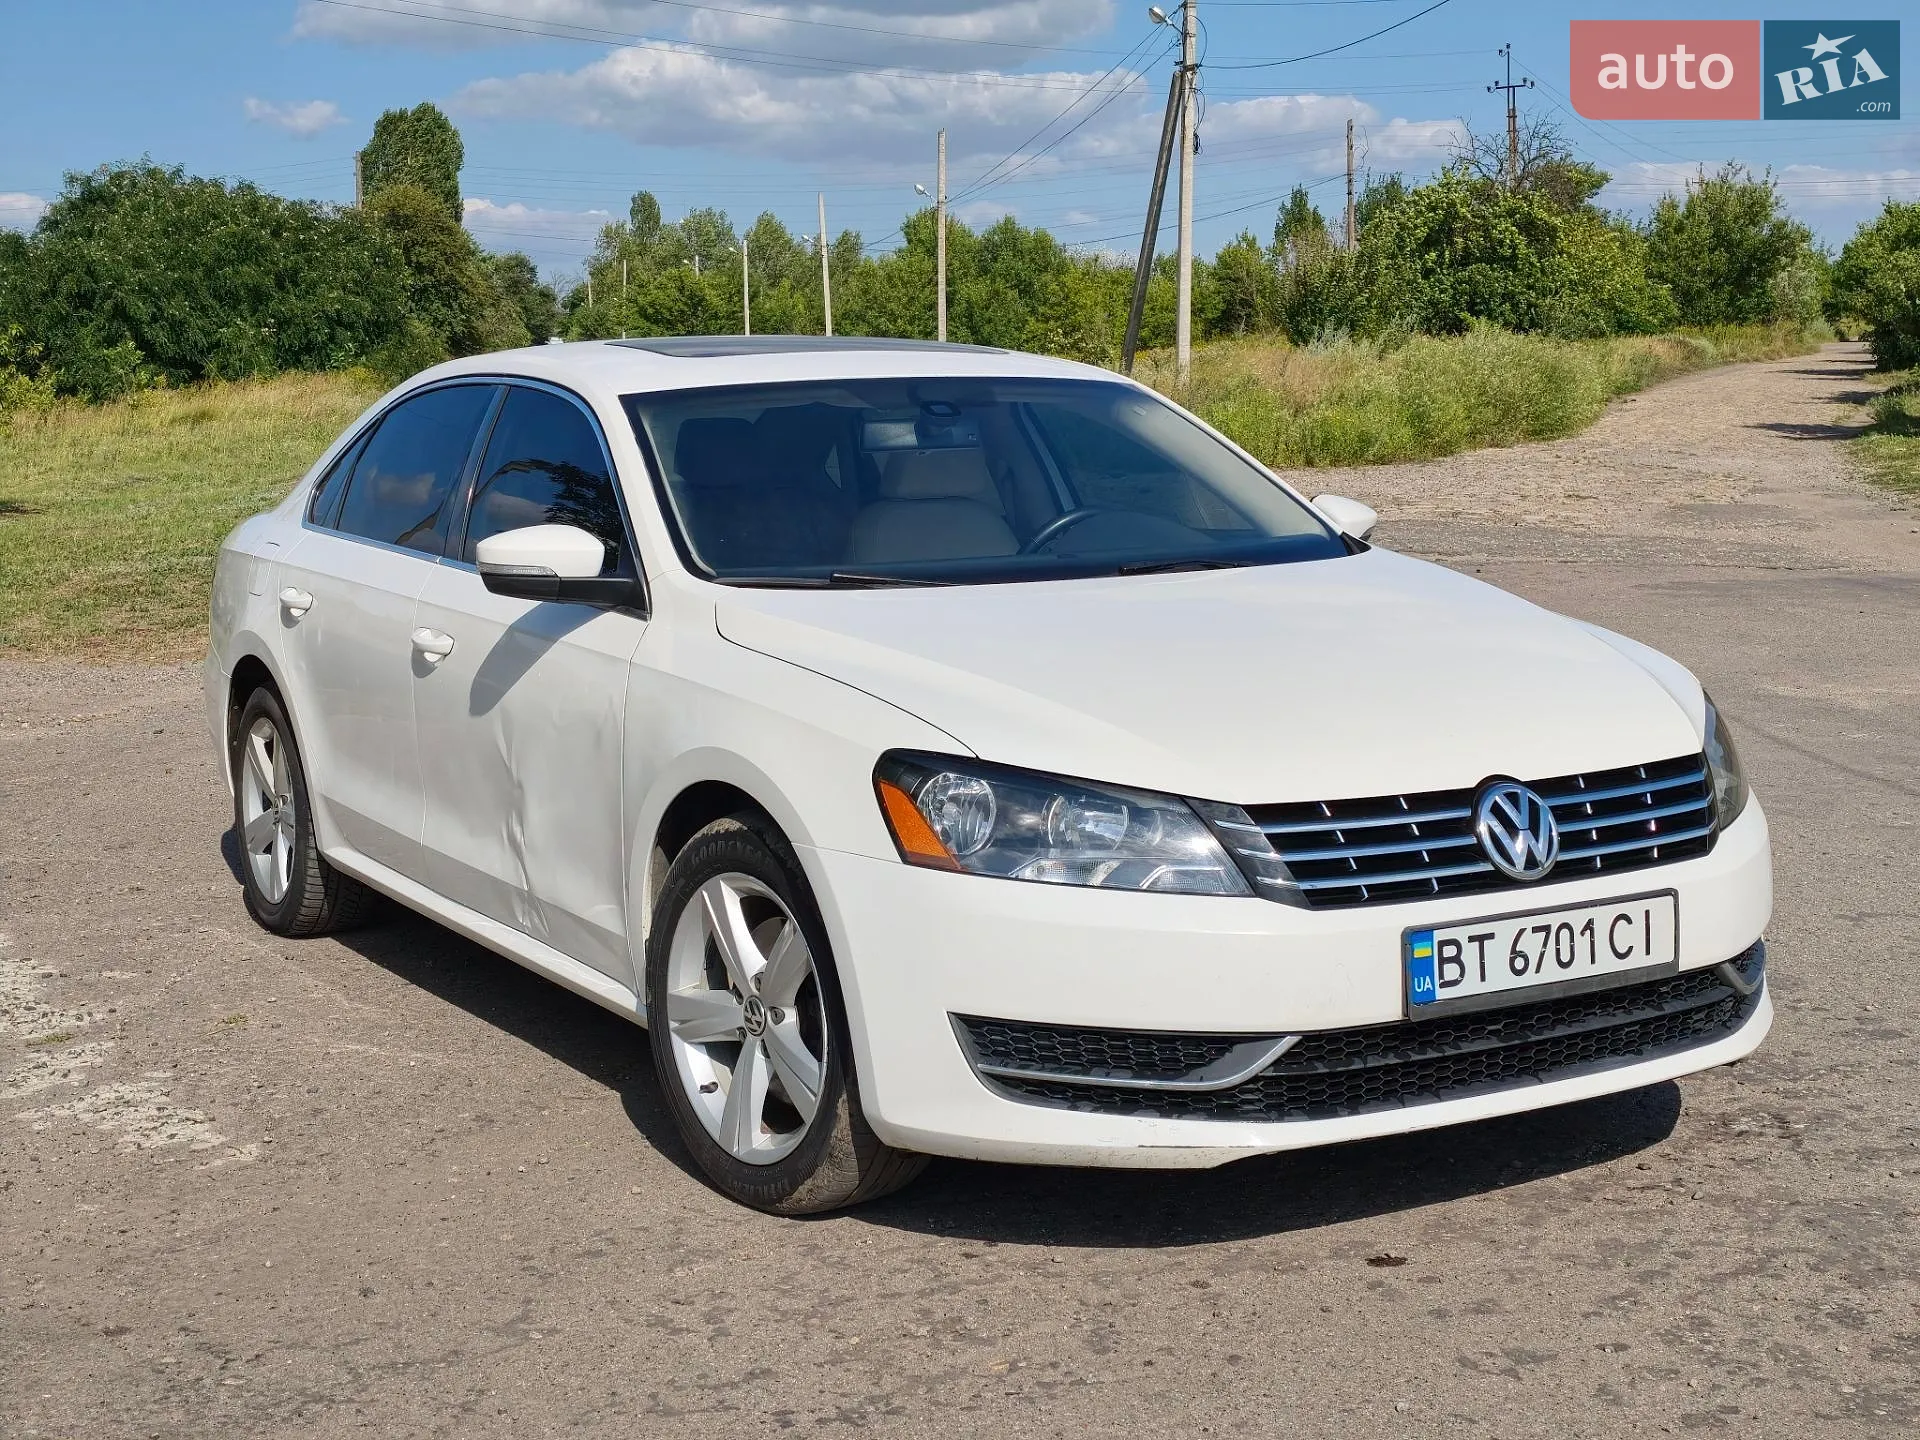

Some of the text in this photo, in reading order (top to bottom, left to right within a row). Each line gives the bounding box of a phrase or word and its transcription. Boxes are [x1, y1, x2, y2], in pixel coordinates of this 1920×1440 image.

[1437, 909, 1651, 989] BT 6701 CI
[1414, 977, 1433, 993] UA
